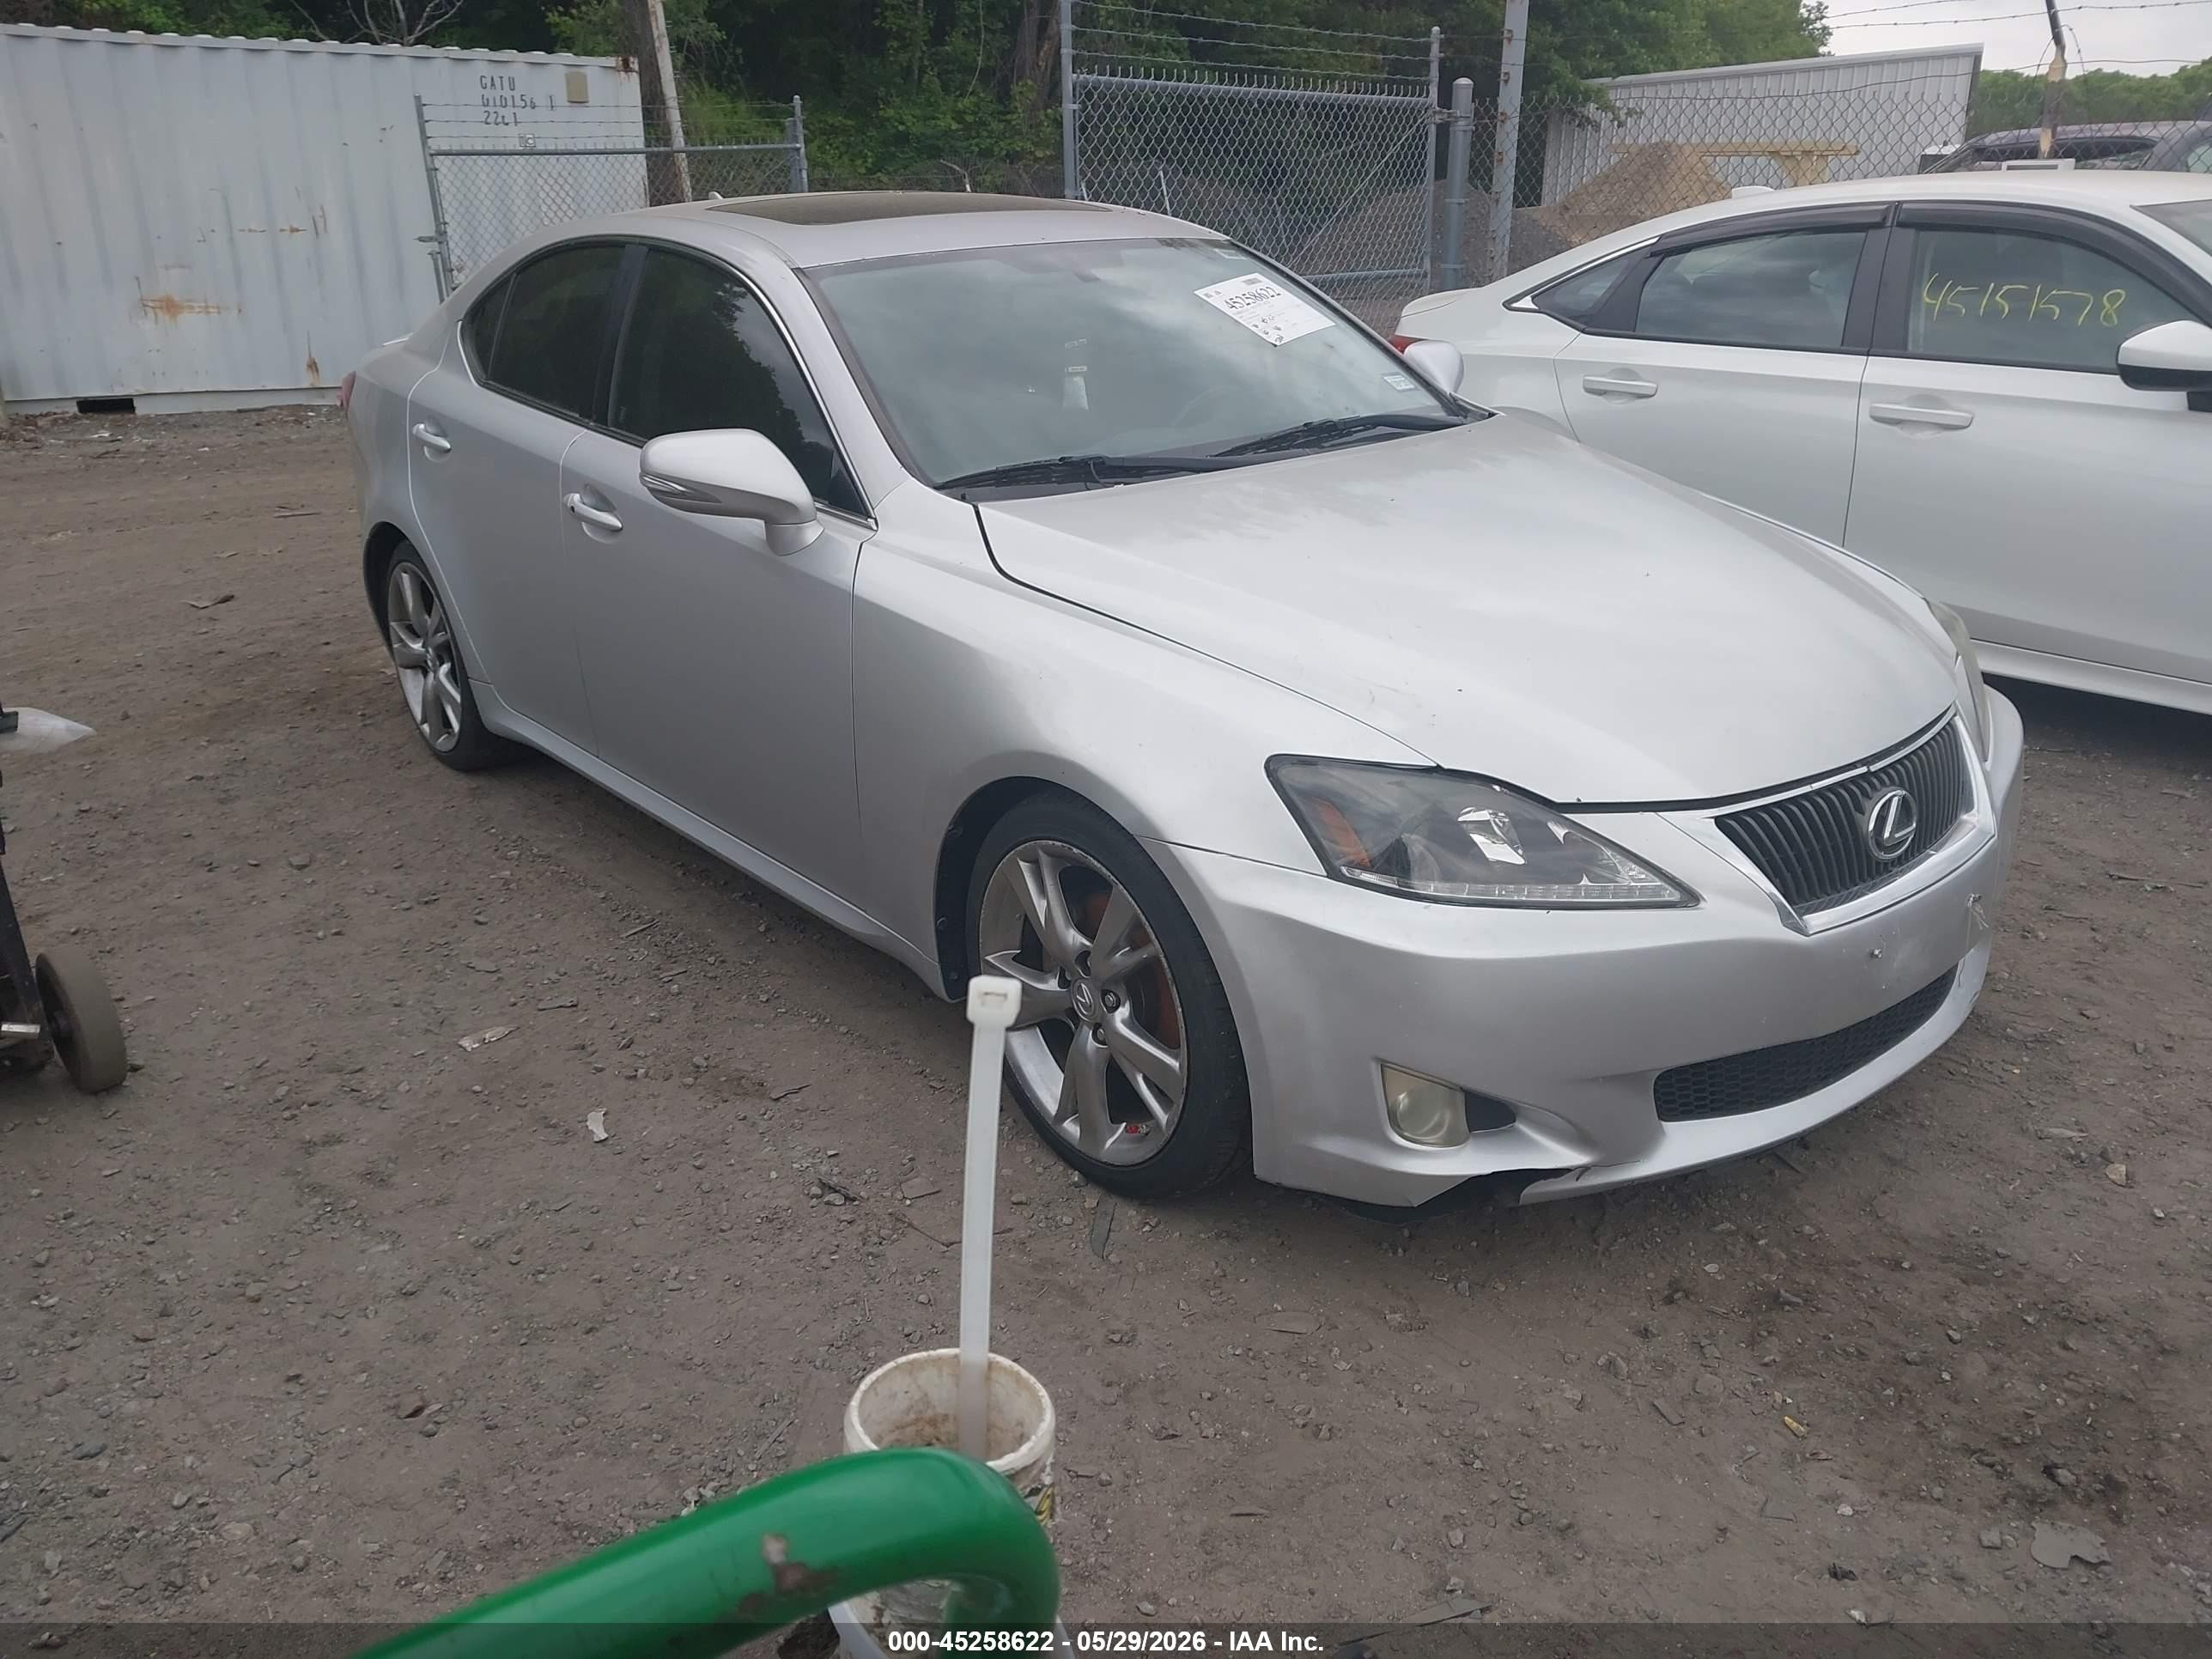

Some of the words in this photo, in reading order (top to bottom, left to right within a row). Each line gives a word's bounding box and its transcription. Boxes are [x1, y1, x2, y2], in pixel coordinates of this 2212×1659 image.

[479, 75, 516, 91] GATU
[1224, 286, 1282, 310] 45258622
[1923, 272, 2126, 327] 45151578
